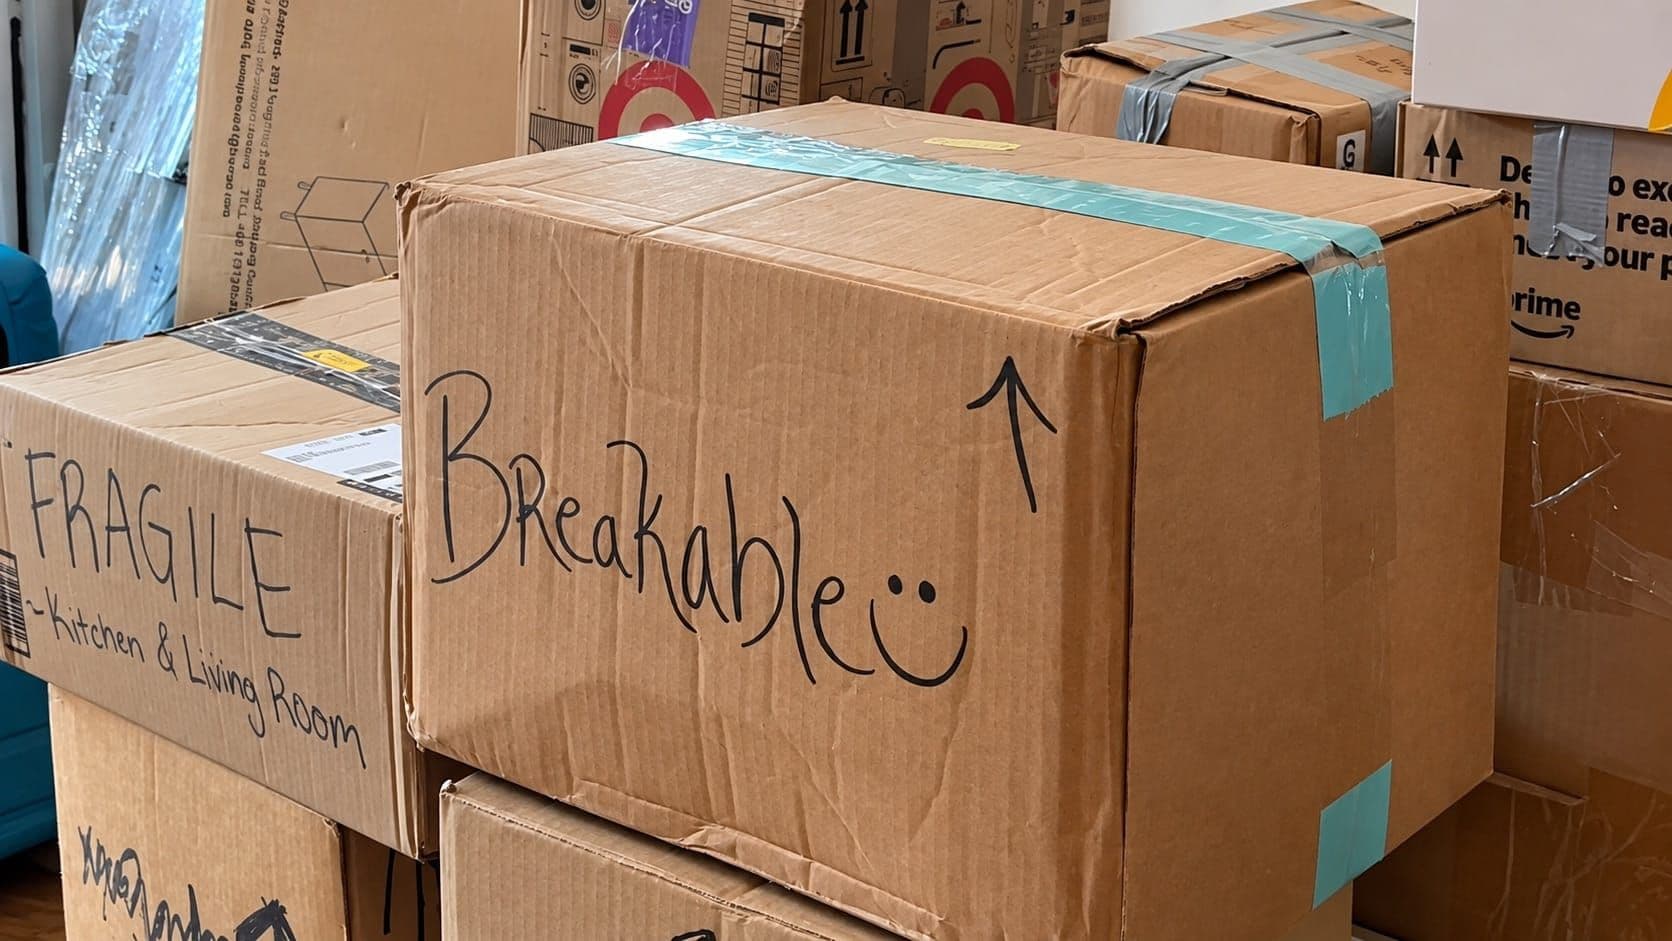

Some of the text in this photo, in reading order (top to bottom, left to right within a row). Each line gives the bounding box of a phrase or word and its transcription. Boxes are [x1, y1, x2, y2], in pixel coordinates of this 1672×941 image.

[1343, 138, 1356, 168] G
[1633, 178, 1672, 202] ex
[1616, 212, 1672, 238] rea
[1511, 287, 1581, 321] rime
[24, 448, 302, 639] FRAGILE
[156, 622, 179, 681] &
[183, 635, 265, 738] Living
[267, 667, 367, 769] Room
